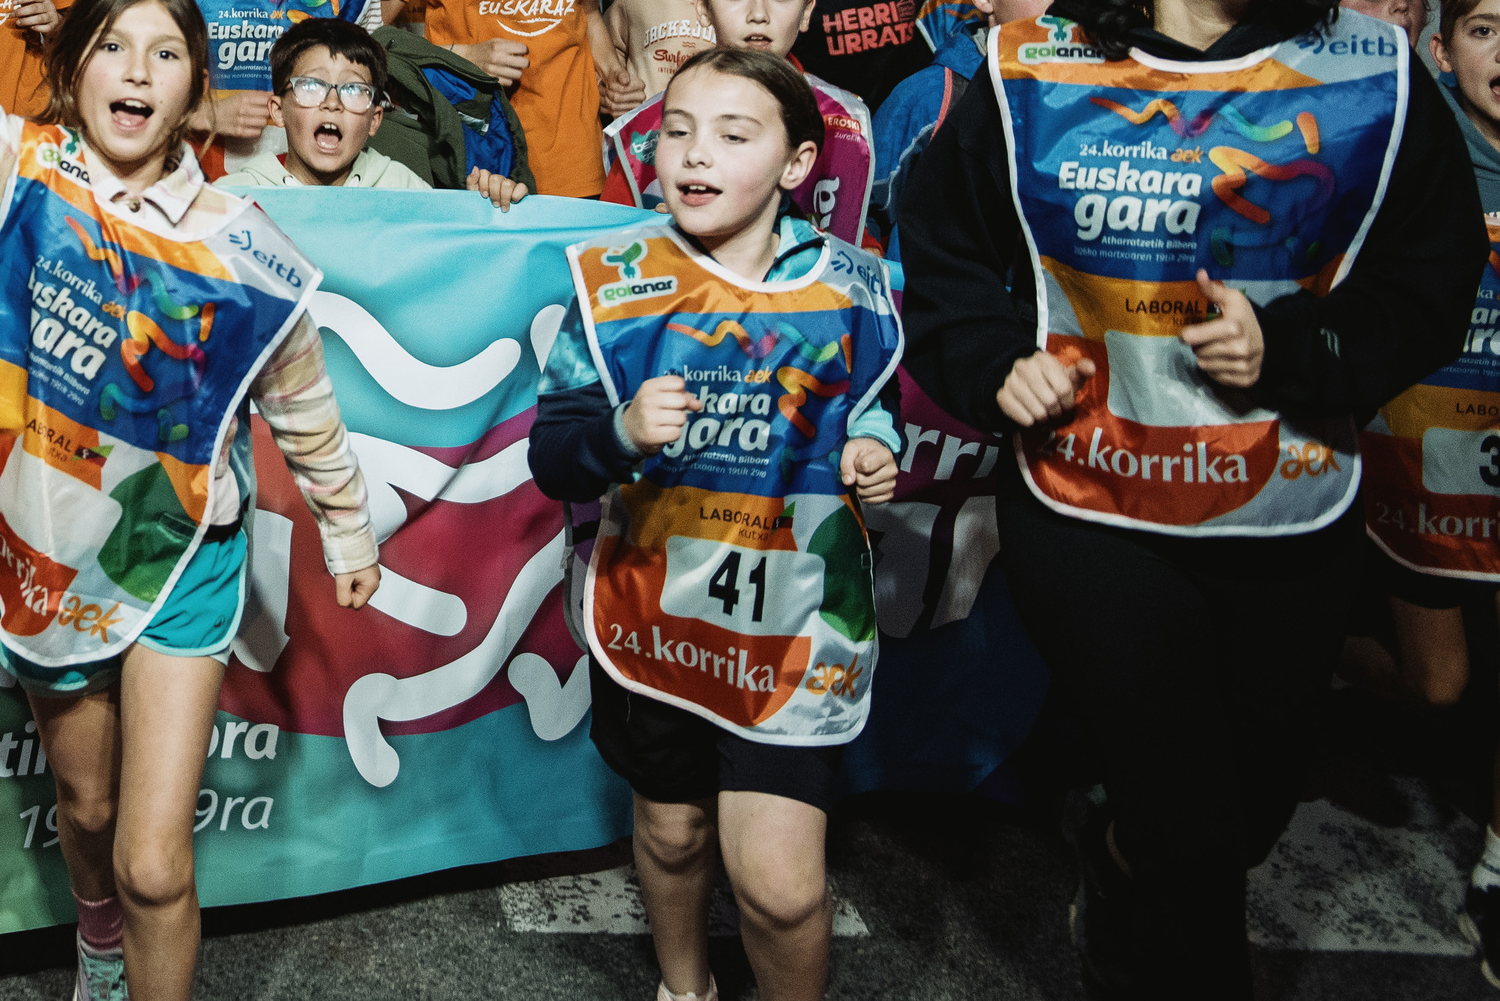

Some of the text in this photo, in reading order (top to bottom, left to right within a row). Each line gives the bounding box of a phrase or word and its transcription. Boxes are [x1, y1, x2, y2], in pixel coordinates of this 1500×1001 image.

[218, 7, 269, 19] 24.korrika
[822, 0, 899, 35] HERRI
[217, 40, 274, 71] gar
[825, 20, 915, 57] URRATS
[1329, 33, 1397, 57] eitb
[827, 116, 860, 131] EROSKI
[1079, 139, 1168, 161] 24.korrika
[1058, 160, 1203, 197] Euskara
[1074, 193, 1202, 242] gara
[35, 254, 104, 305] 24.korrika
[252, 245, 303, 289] eitb
[28, 266, 118, 349] skara
[1126, 298, 1203, 315] LABORAL
[664, 365, 773, 384] korrika aek
[686, 385, 772, 416] kara
[1456, 402, 1500, 416] LABO
[699, 506, 770, 530] LABORAL
[1375, 501, 1500, 539] 24.korr
[707, 550, 767, 623] 41
[57, 595, 124, 644] aek
[607, 623, 864, 699] 24.korrika aek
[192, 788, 274, 834] 9ra
